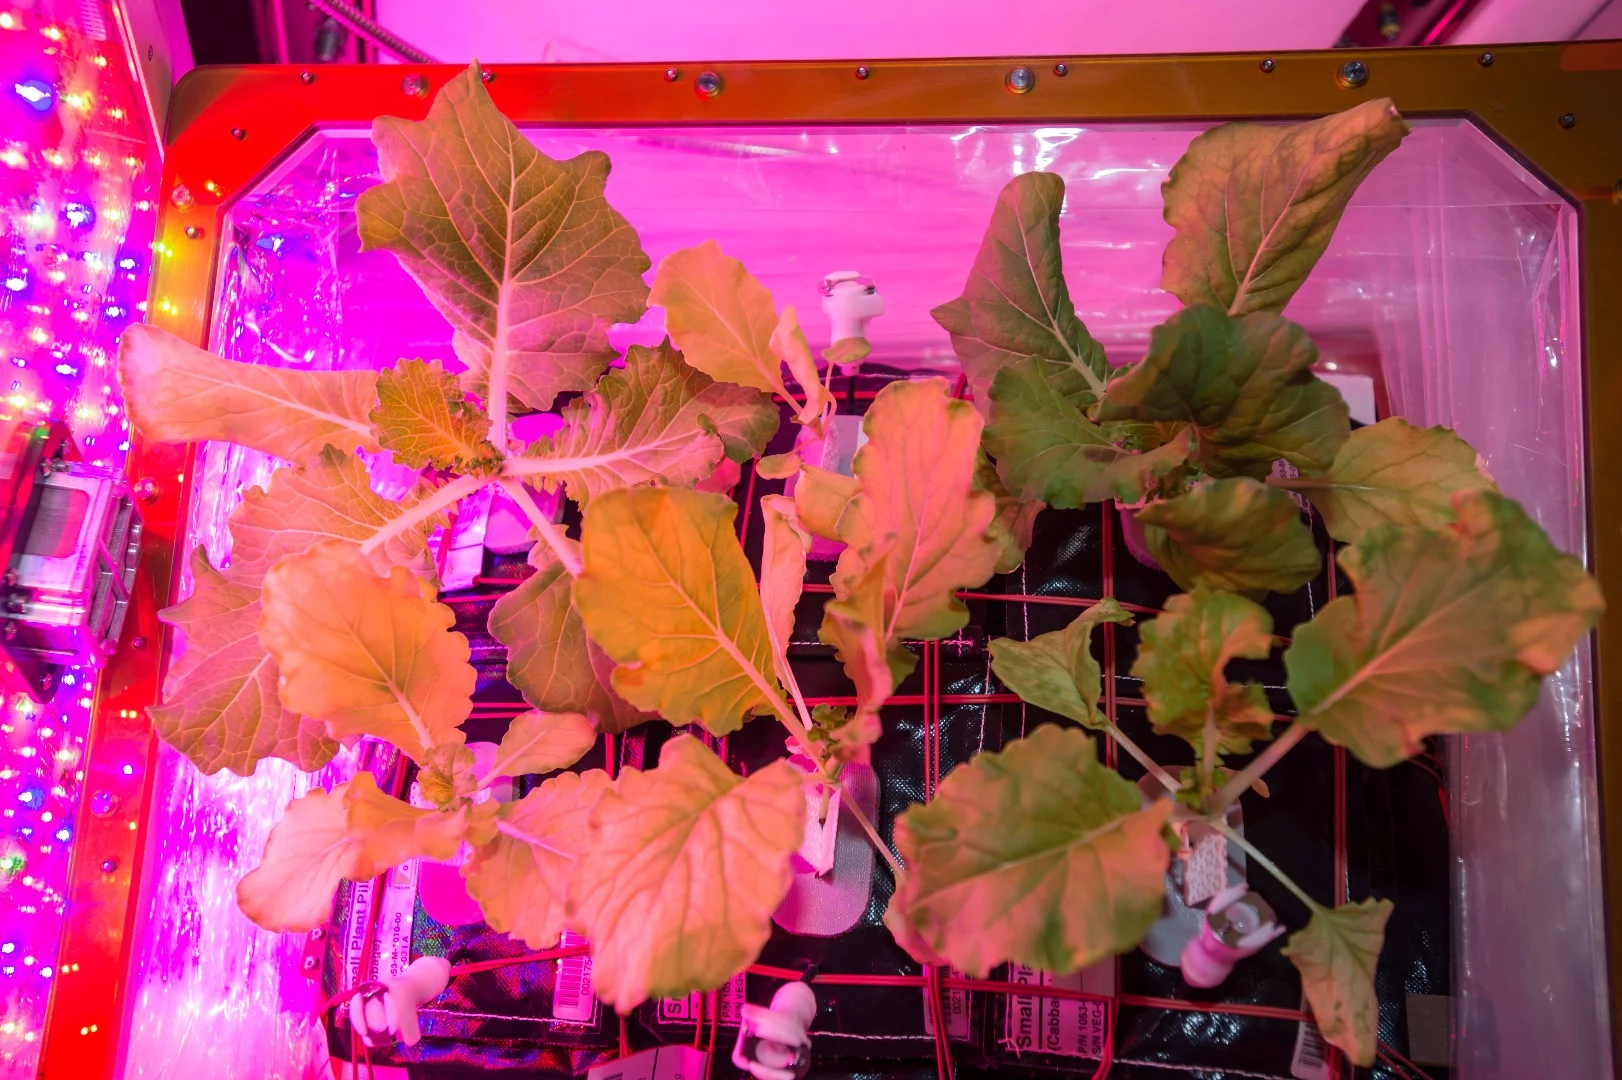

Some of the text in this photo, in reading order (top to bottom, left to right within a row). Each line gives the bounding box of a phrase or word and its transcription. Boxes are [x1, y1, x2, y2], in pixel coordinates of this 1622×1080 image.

[351, 909, 367, 951] Plant
[390, 912, 402, 977] 53-M-1010-00
[722, 976, 732, 1019] P/N 105
[734, 971, 744, 999] VEG-
[1015, 994, 1033, 1050] Small
[1077, 1000, 1088, 1054] P/N 1053-
[1091, 1035, 1102, 1057] S/N
